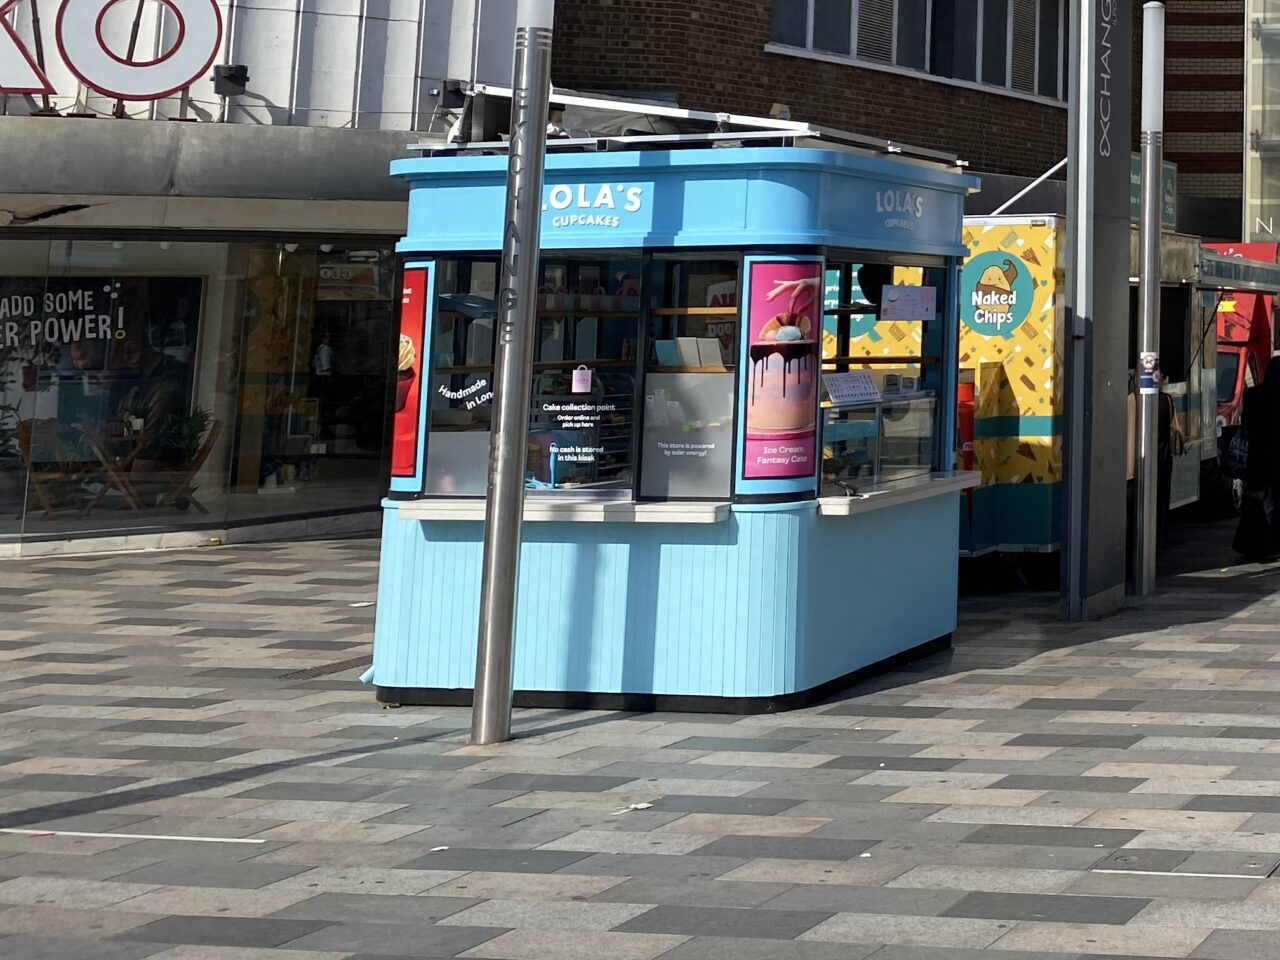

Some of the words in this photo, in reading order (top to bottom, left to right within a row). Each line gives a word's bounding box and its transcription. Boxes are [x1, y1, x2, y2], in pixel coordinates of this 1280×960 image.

[876, 190, 923, 218] LOLA'S
[500, 88, 528, 345] EXCHANGE
[552, 213, 620, 228] CUPCAKES
[0, 295, 34, 319] ADD
[44, 289, 94, 313] SOME
[971, 290, 1017, 306] Naked
[30, 307, 126, 346] POWER!
[973, 309, 1014, 331] Chips
[438, 378, 487, 399] Handmade
[465, 399, 476, 411] in
[475, 391, 495, 405] Lon
[542, 403, 561, 411] Cake
[561, 403, 596, 411] collection
[596, 404, 616, 412] point
[763, 446, 777, 454] Ice
[778, 445, 805, 454] Cream
[756, 456, 790, 465] Fantasy
[790, 455, 808, 464] Cake
